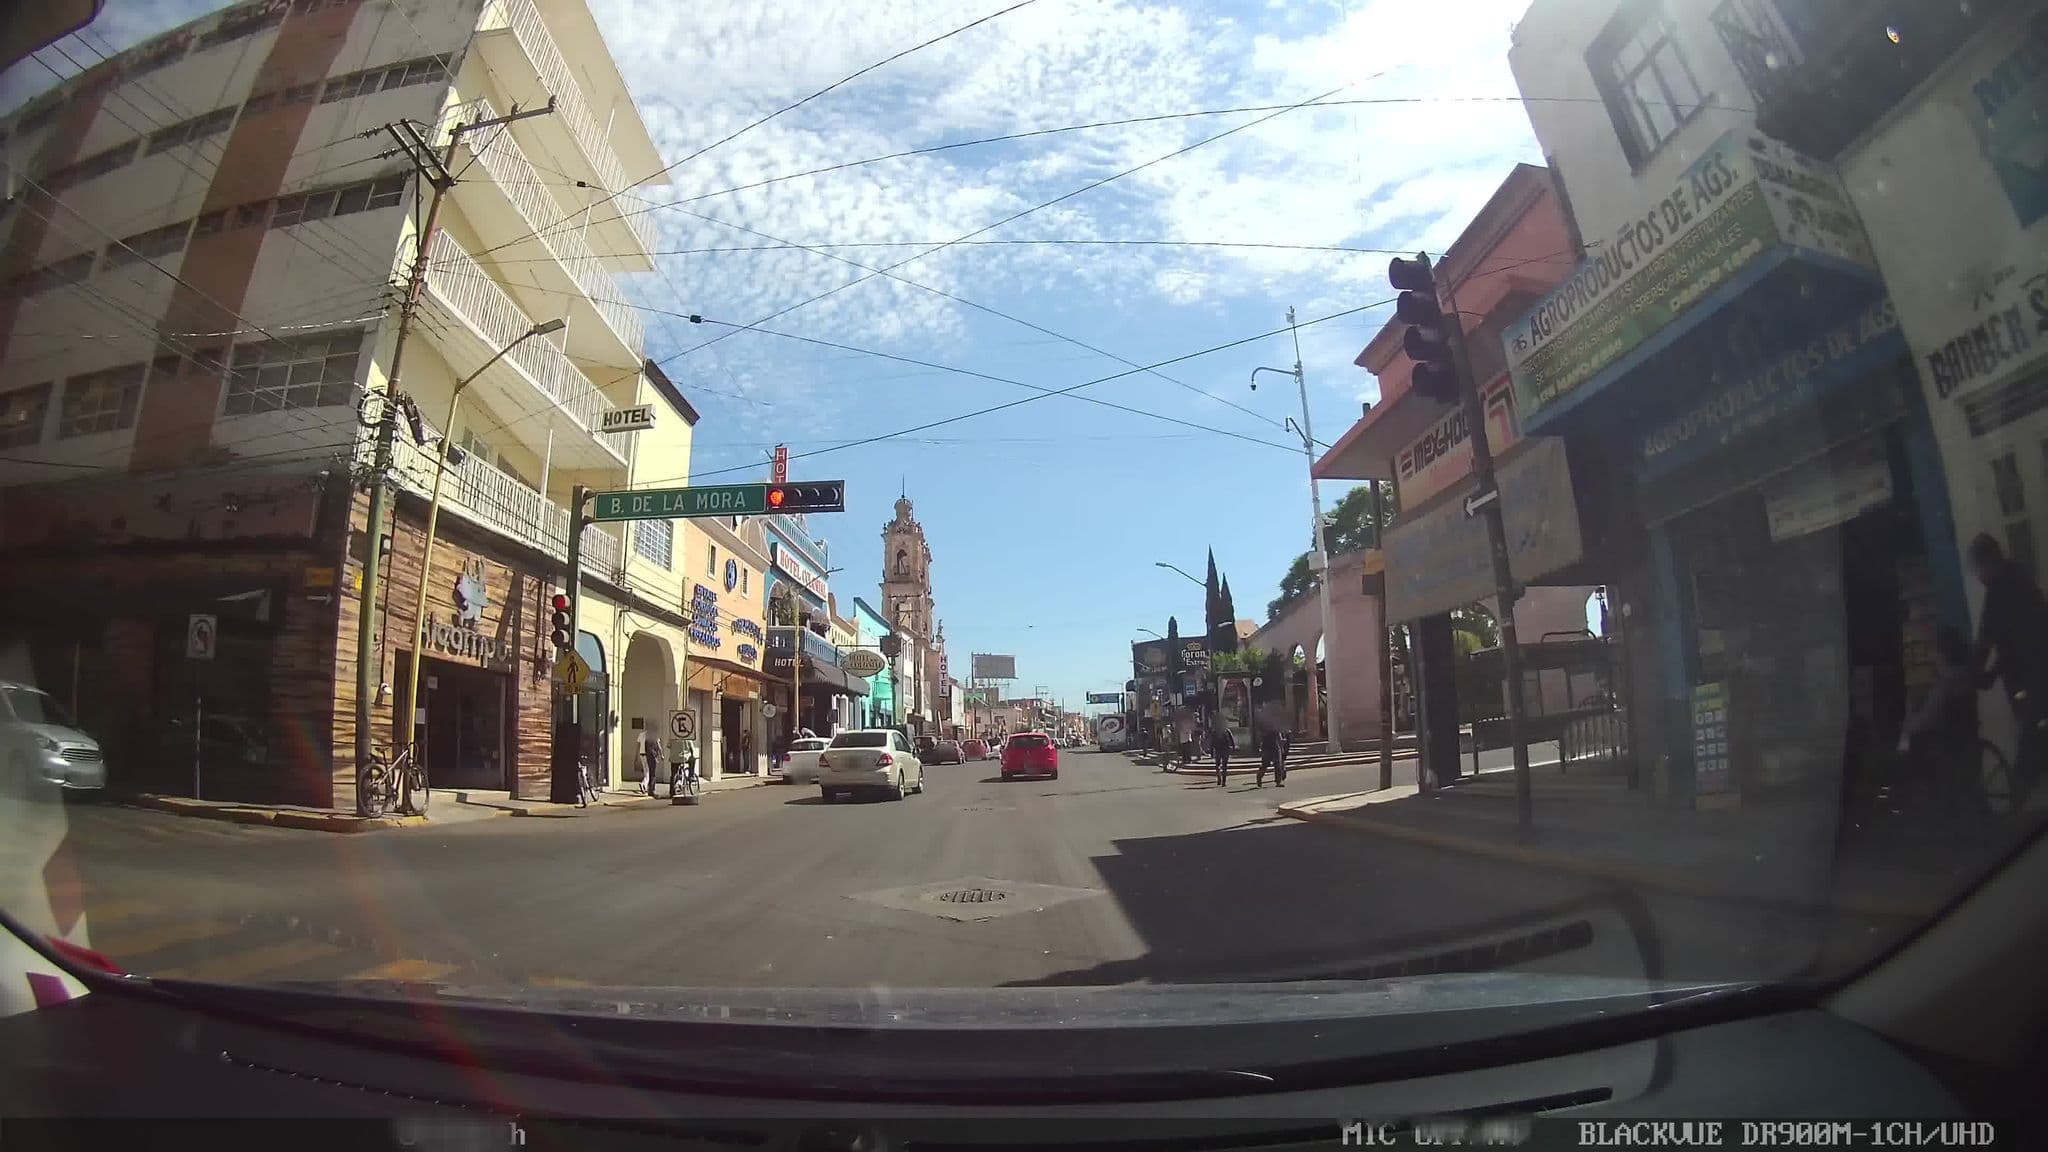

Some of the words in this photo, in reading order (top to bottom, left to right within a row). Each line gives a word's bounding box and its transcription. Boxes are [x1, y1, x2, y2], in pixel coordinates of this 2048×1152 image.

[1529, 210, 1665, 346] AGROPRODUCTOS
[1660, 186, 1693, 235] DE
[1689, 151, 1739, 214] AGS.
[604, 409, 650, 427] HOTEL
[611, 498, 625, 514] B.
[633, 496, 652, 513] DE
[663, 493, 685, 512] LA
[696, 490, 746, 509] MORA
